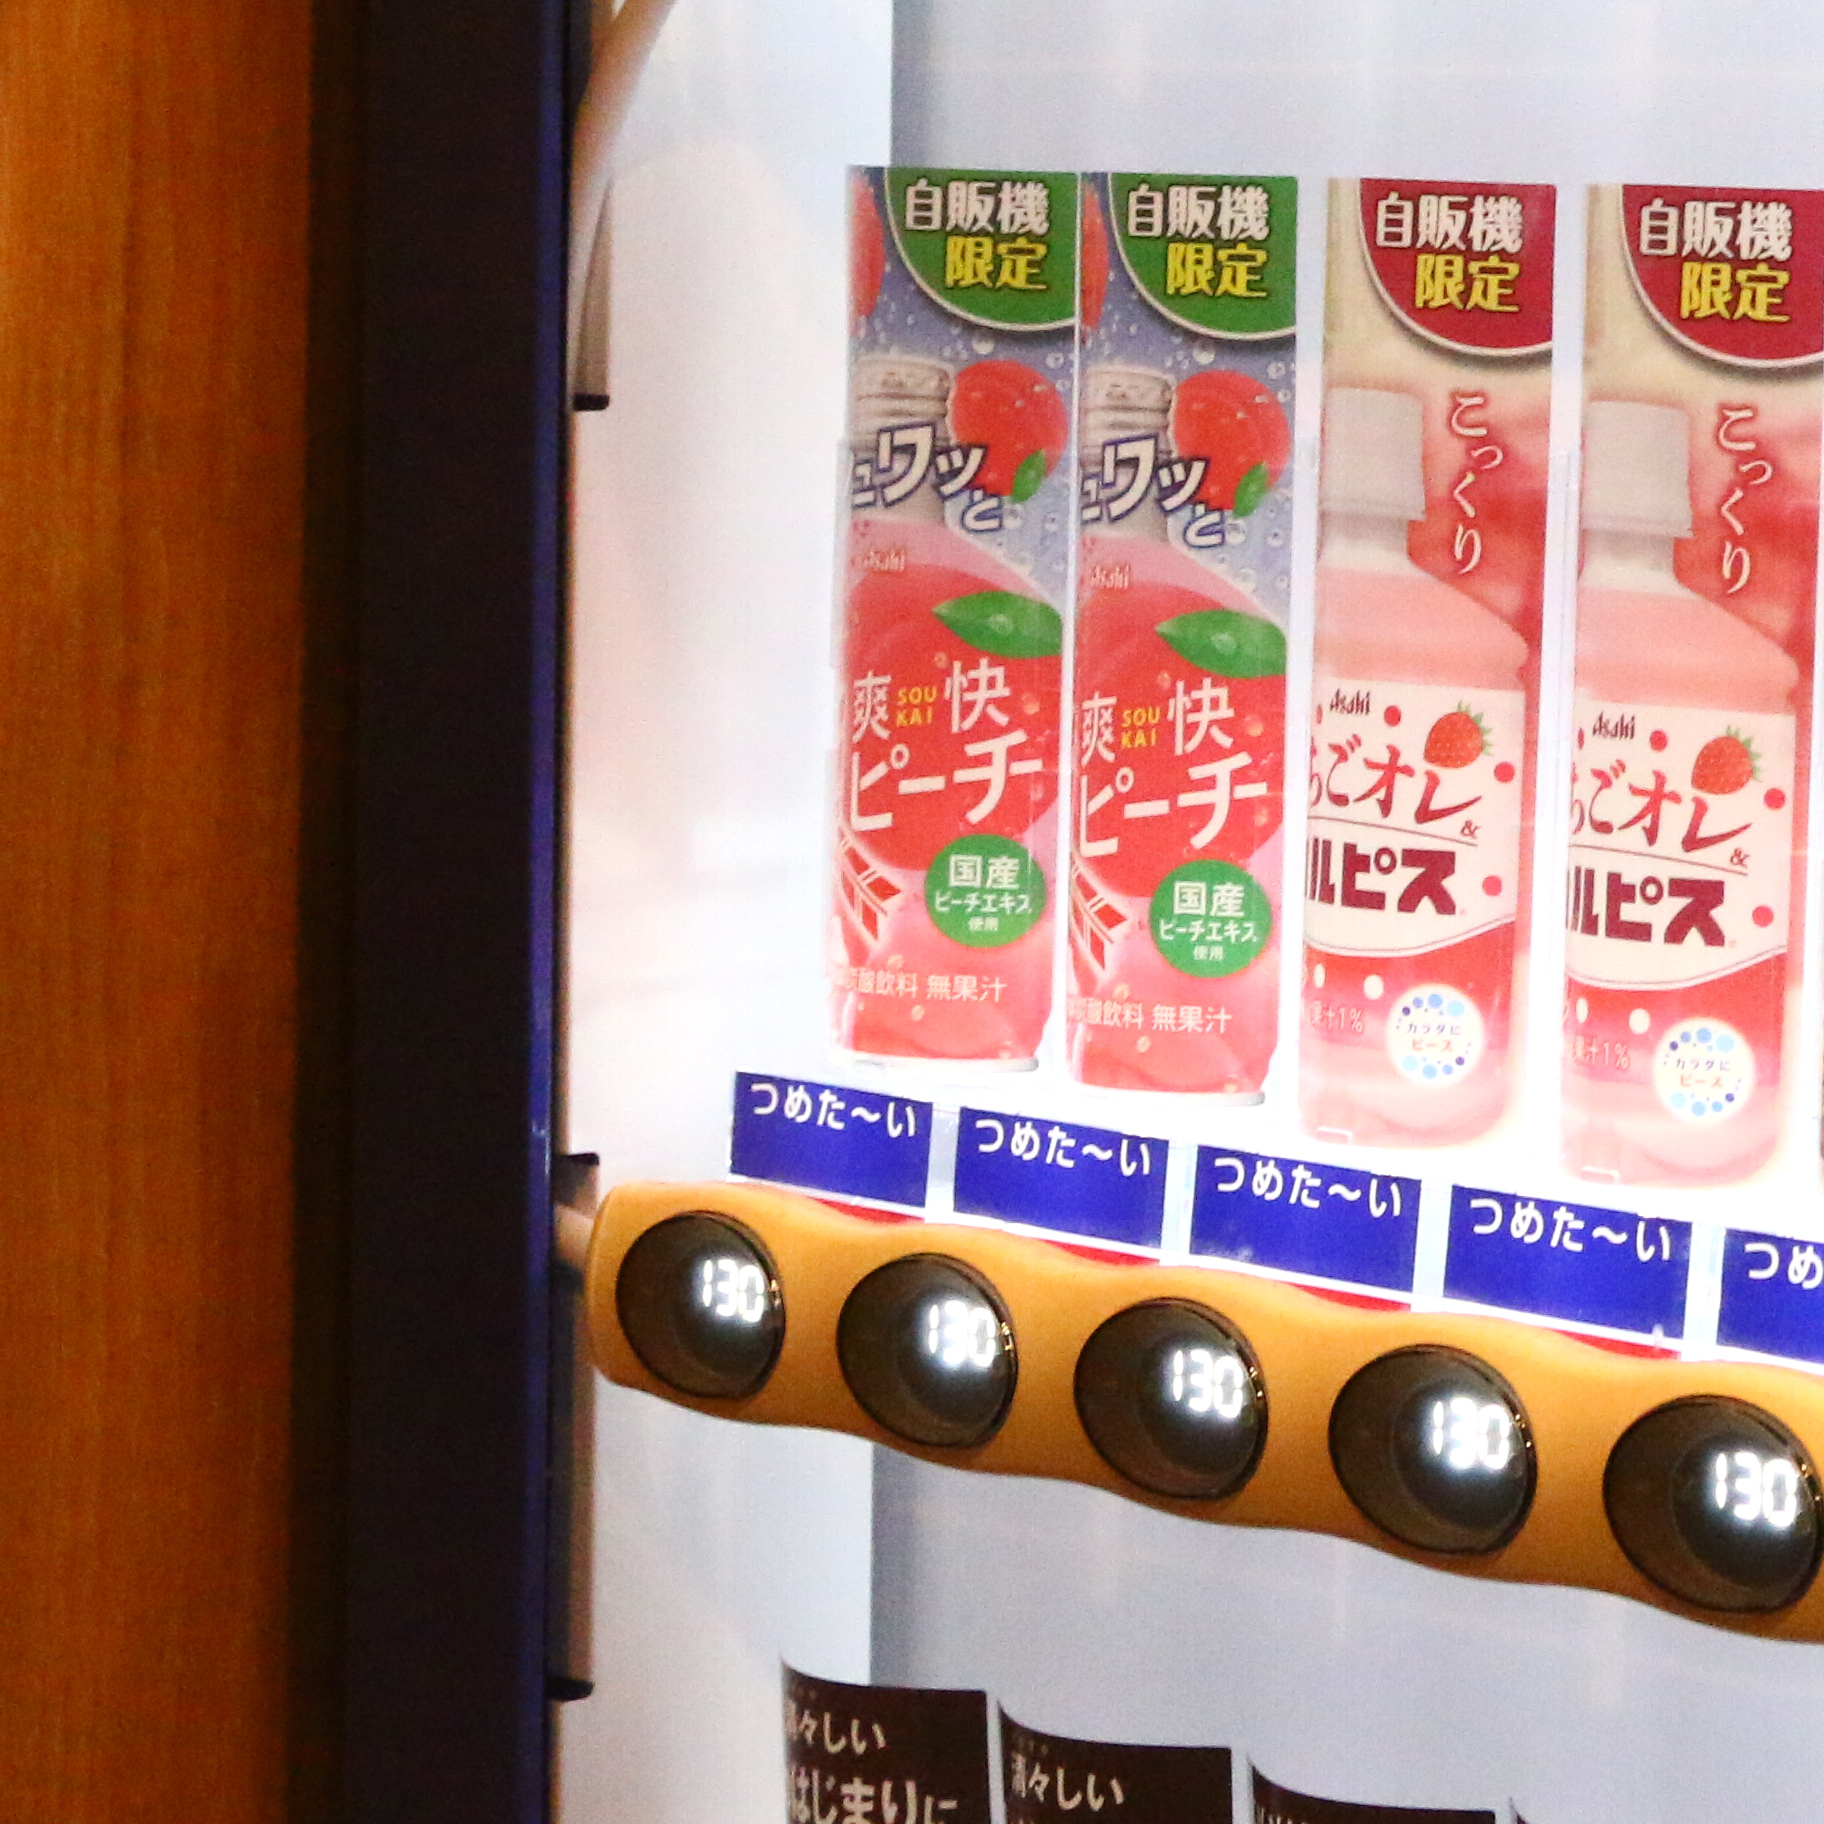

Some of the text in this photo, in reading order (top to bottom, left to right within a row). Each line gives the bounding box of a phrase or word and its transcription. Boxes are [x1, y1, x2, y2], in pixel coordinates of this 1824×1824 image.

[905, 178, 1050, 235] 自販機
[1127, 184, 1270, 240] 自販機
[944, 235, 1049, 290] 限定
[1166, 242, 1269, 298] 限定
[1450, 393, 1504, 575] こっくり
[897, 686, 937, 705] SOU
[850, 729, 1044, 833] ピーチ
[947, 854, 1021, 890] 国産
[1172, 880, 1245, 917] 国産
[702, 1258, 766, 1324] 130
[928, 1300, 996, 1369] 130
[1171, 1348, 1243, 1420] 130
[1432, 1398, 1511, 1471] 130
[1715, 1451, 1799, 1529] 130
